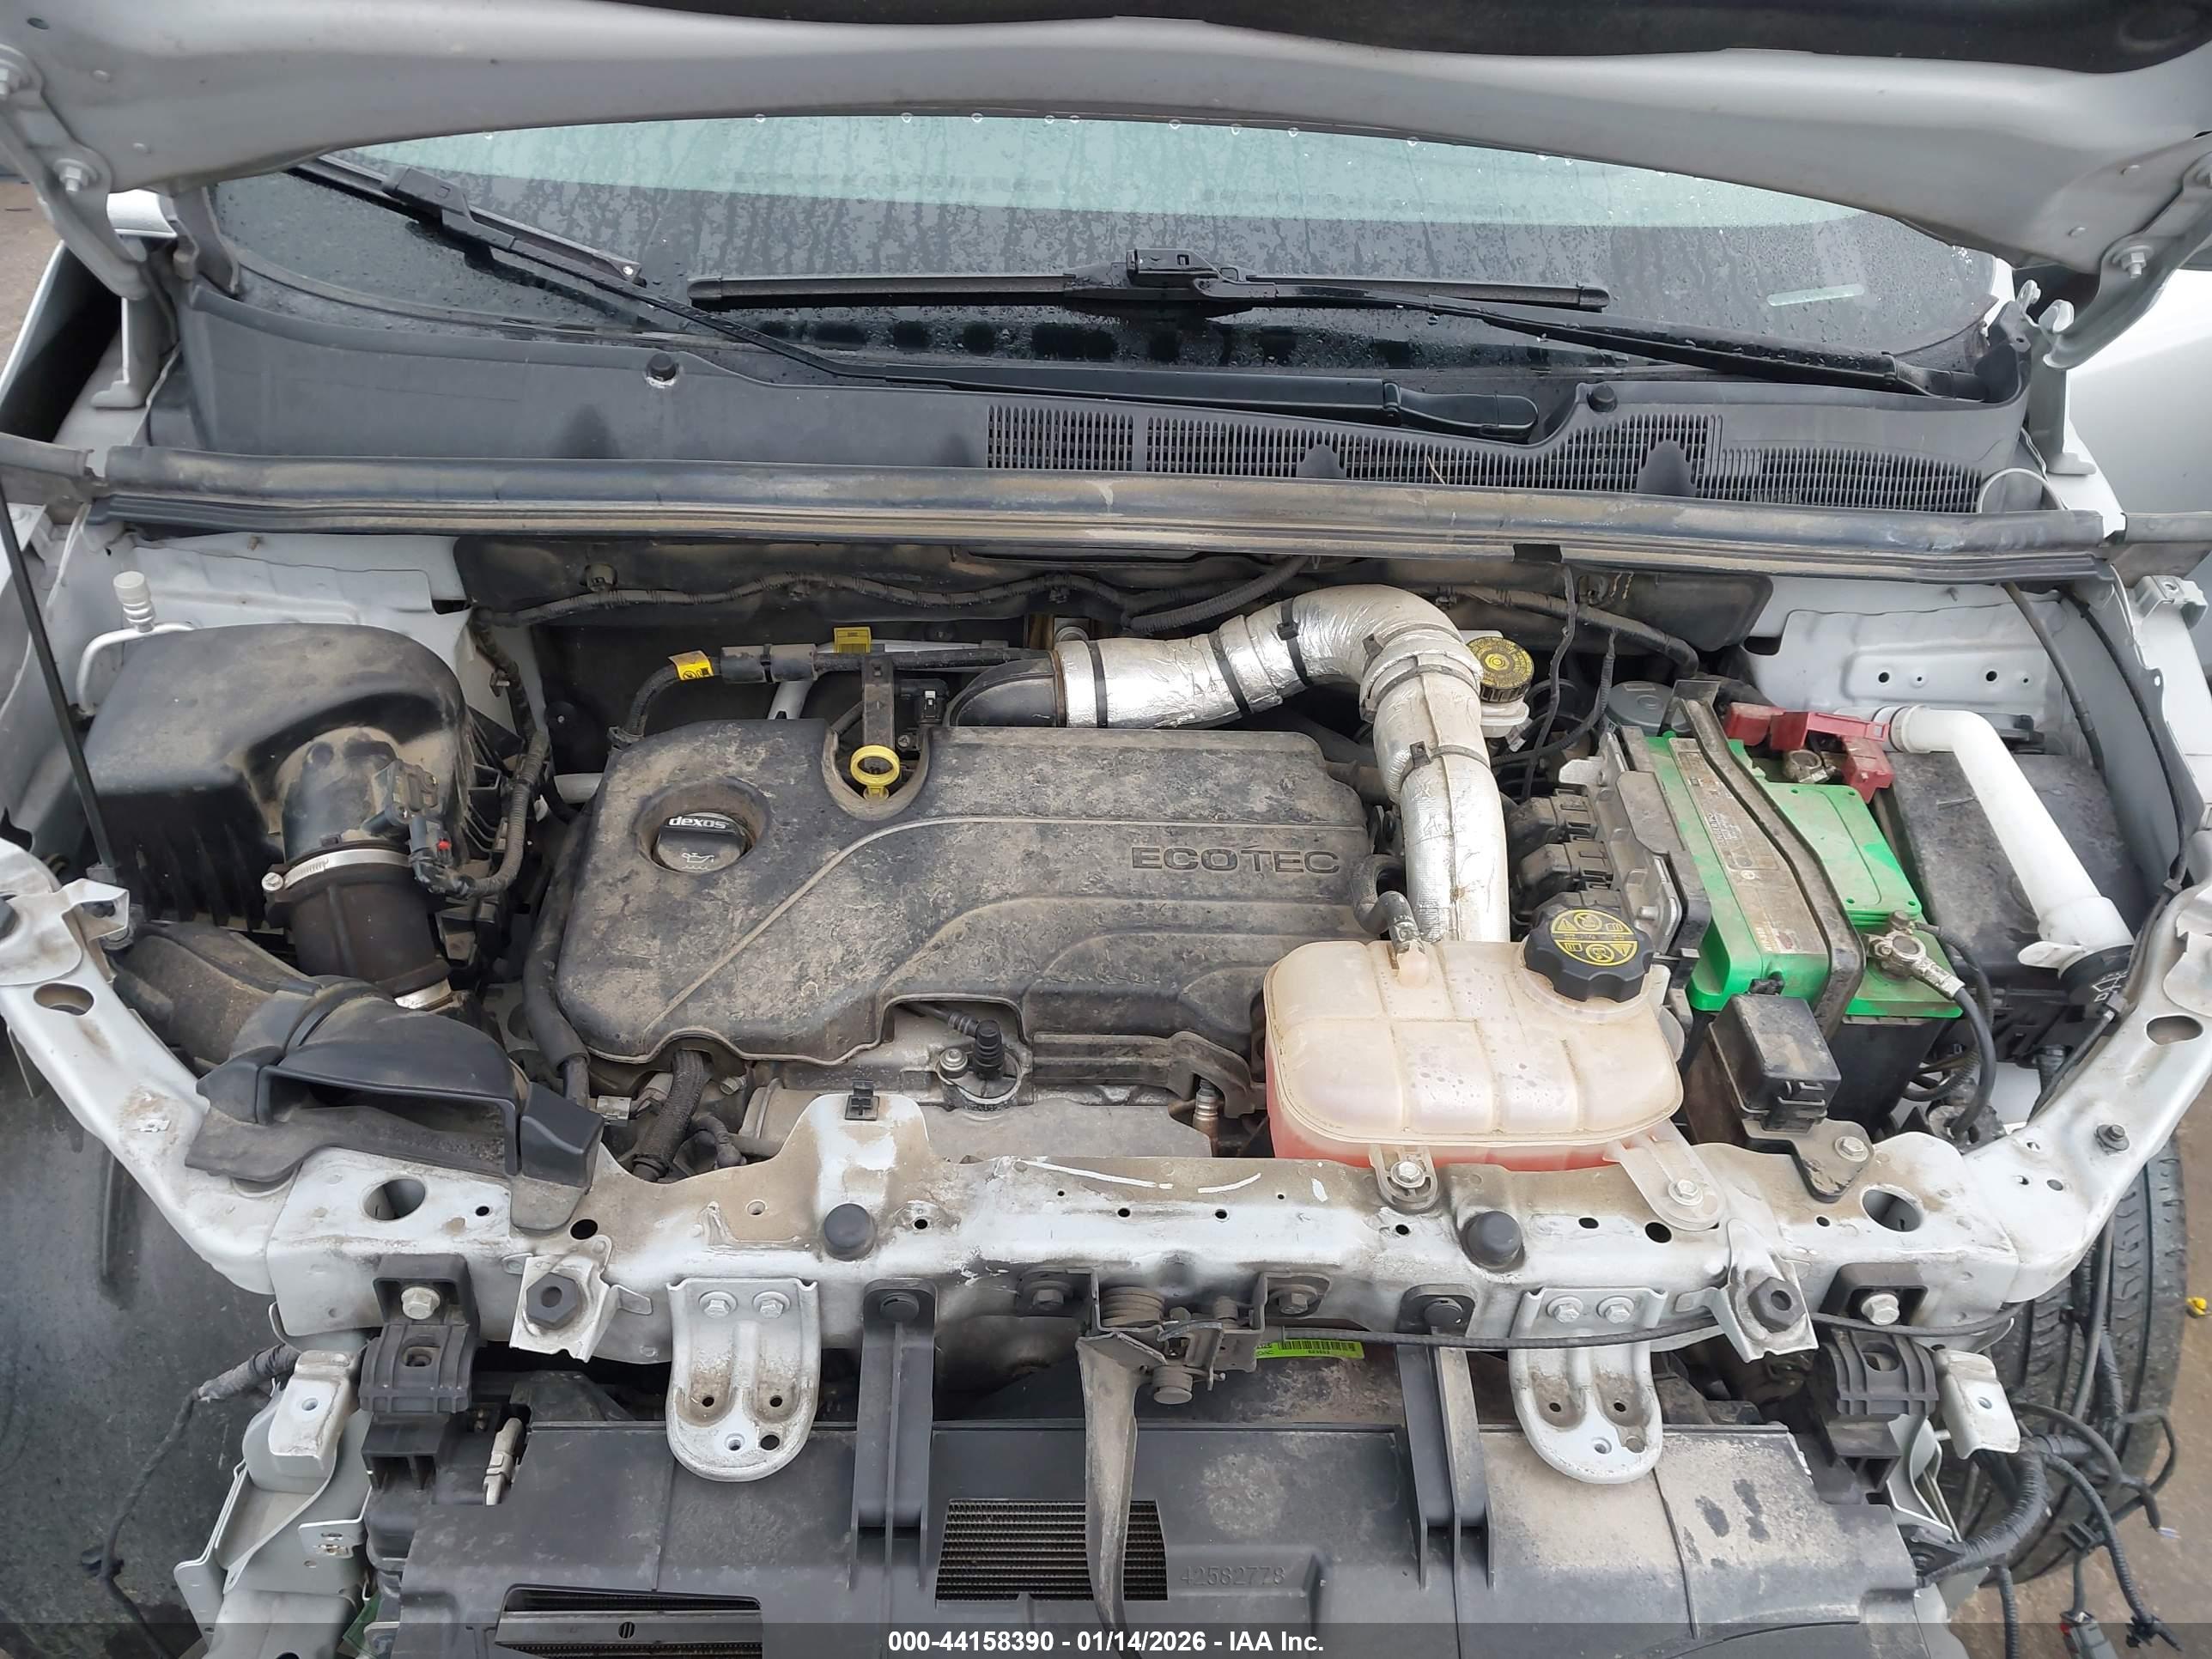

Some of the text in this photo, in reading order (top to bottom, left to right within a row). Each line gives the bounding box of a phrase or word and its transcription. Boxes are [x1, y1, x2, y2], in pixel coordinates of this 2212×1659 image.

[668, 816, 730, 830] dexos
[1131, 847, 1340, 874] ECOTEC
[1181, 1565, 1285, 1585] 42582778
